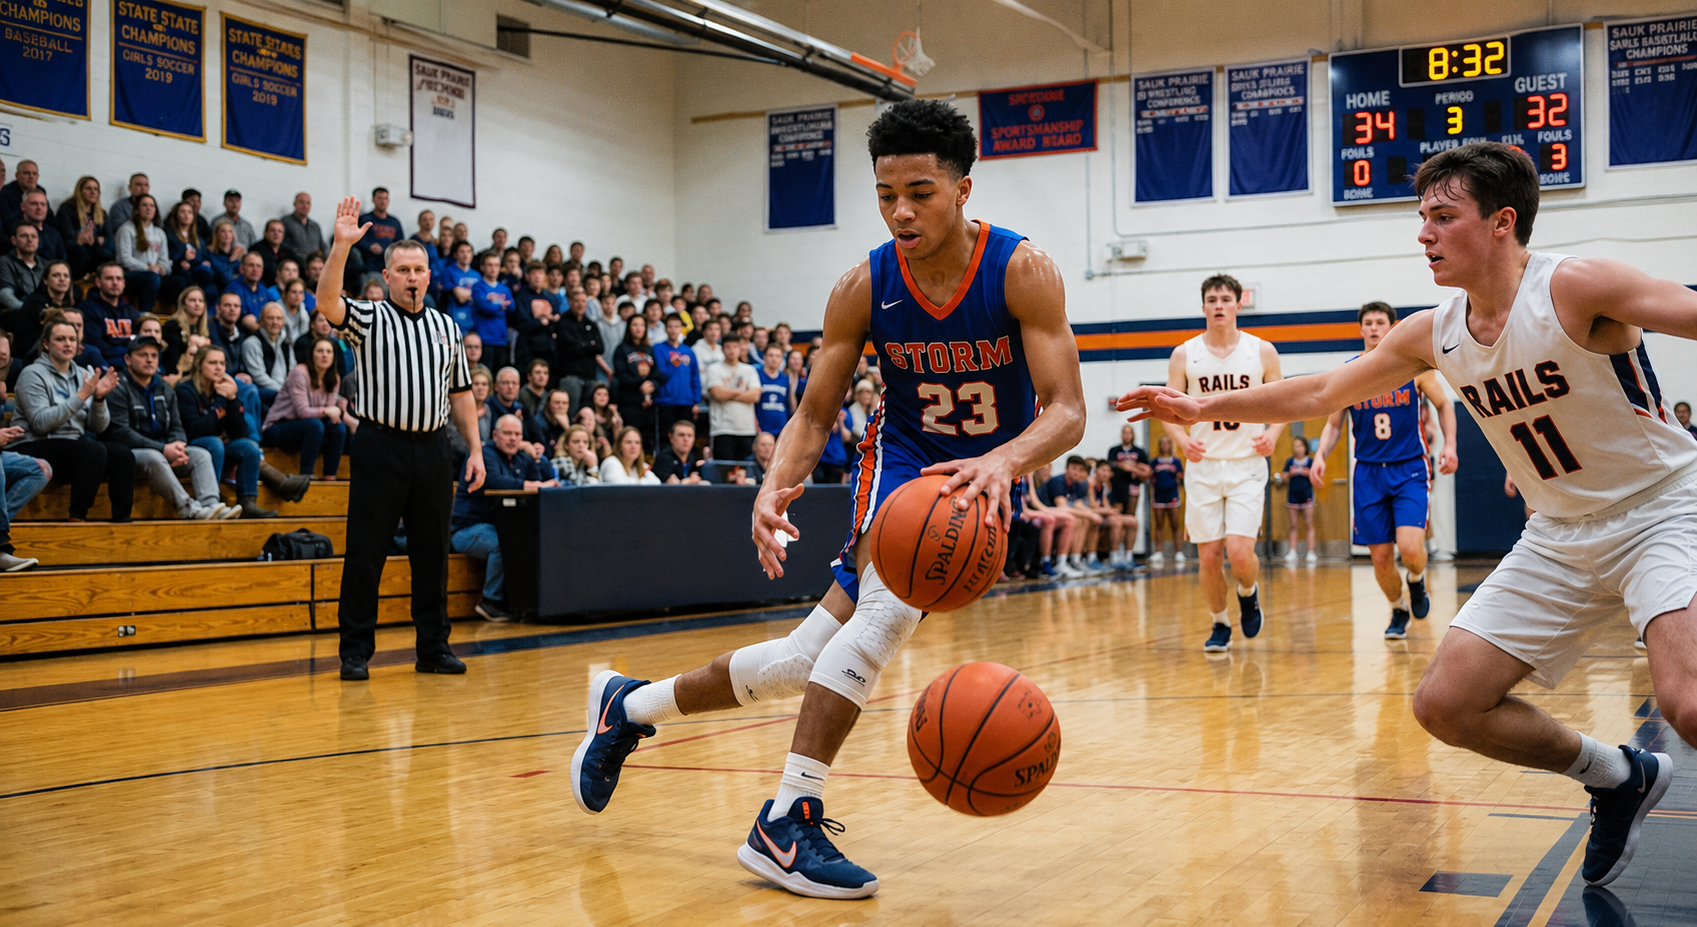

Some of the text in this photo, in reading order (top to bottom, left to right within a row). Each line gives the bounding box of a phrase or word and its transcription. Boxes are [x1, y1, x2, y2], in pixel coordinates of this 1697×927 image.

[0, 0, 81, 32] CHAMPIONS
[118, 1, 199, 35] STATE STATE
[1612, 19, 1697, 39] SAUK PRAIRIE
[5, 27, 73, 53] BASEBALL
[121, 24, 196, 55] CHAMPIONS
[228, 28, 263, 48] STATE
[22, 46, 53, 62] 2017
[157, 56, 195, 75] SOCCER
[231, 49, 298, 78] CHAMPIONS
[1428, 41, 1505, 81] 8:32
[145, 67, 173, 84] 2019
[1514, 73, 1568, 93] GUEST
[252, 90, 278, 106] 2019
[1346, 90, 1391, 110] HOME
[1527, 93, 1568, 129] 32
[991, 119, 1084, 140] SPORTSMANSHIP
[1355, 110, 1395, 145] 34
[1447, 106, 1463, 135] 3
[992, 137, 1036, 152] AWARD
[1538, 129, 1572, 143] FOULS
[1341, 146, 1375, 160] FOULS
[1551, 143, 1567, 171] 3
[1353, 160, 1370, 186] 0
[884, 335, 1013, 374] STORM
[1199, 373, 1250, 393] RAILS
[1460, 360, 1570, 418] RAILS
[916, 380, 1000, 436] 23
[1373, 412, 1392, 441] 8
[1510, 414, 1583, 480] 11
